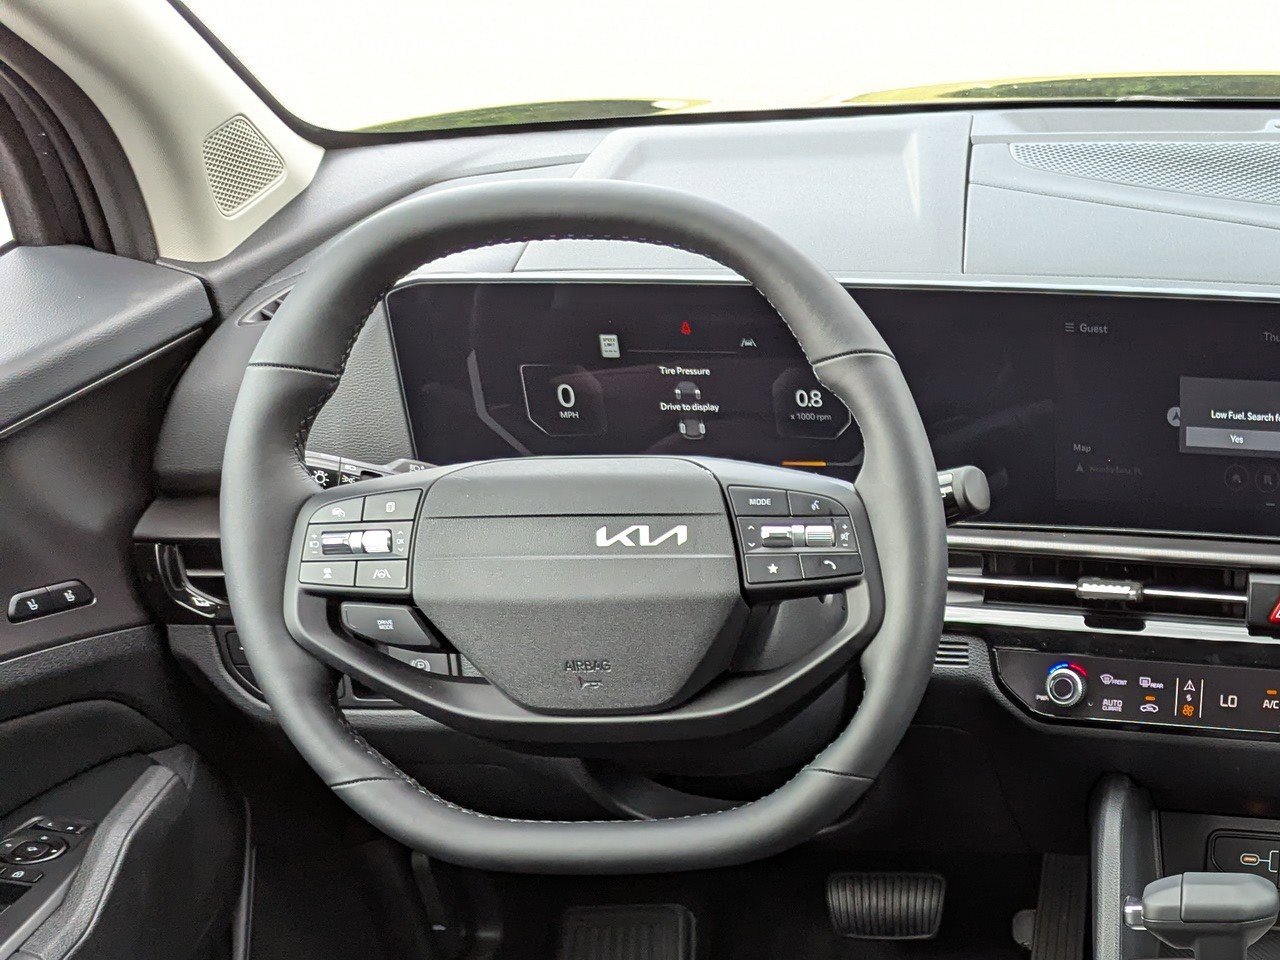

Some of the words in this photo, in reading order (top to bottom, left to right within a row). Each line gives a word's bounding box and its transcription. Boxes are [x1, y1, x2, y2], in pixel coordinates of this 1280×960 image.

[1080, 323, 1107, 333] Guest
[659, 366, 675, 375] Tire
[676, 366, 710, 376] Pressure
[557, 384, 575, 408] 0
[795, 389, 823, 408] 0.8
[660, 402, 681, 411] Drive
[682, 403, 691, 411] to
[692, 403, 720, 412] display
[560, 411, 579, 419] MPH
[1211, 409, 1227, 419] Low
[1228, 411, 1246, 420] Fuel.
[1247, 412, 1274, 422] Search
[1230, 435, 1243, 444] Yes
[1073, 443, 1091, 453] Map
[565, 660, 611, 671] AIRBAG
[1102, 699, 1123, 707] AUTO
[1220, 694, 1238, 708] LO
[1263, 700, 1279, 709] A/C
